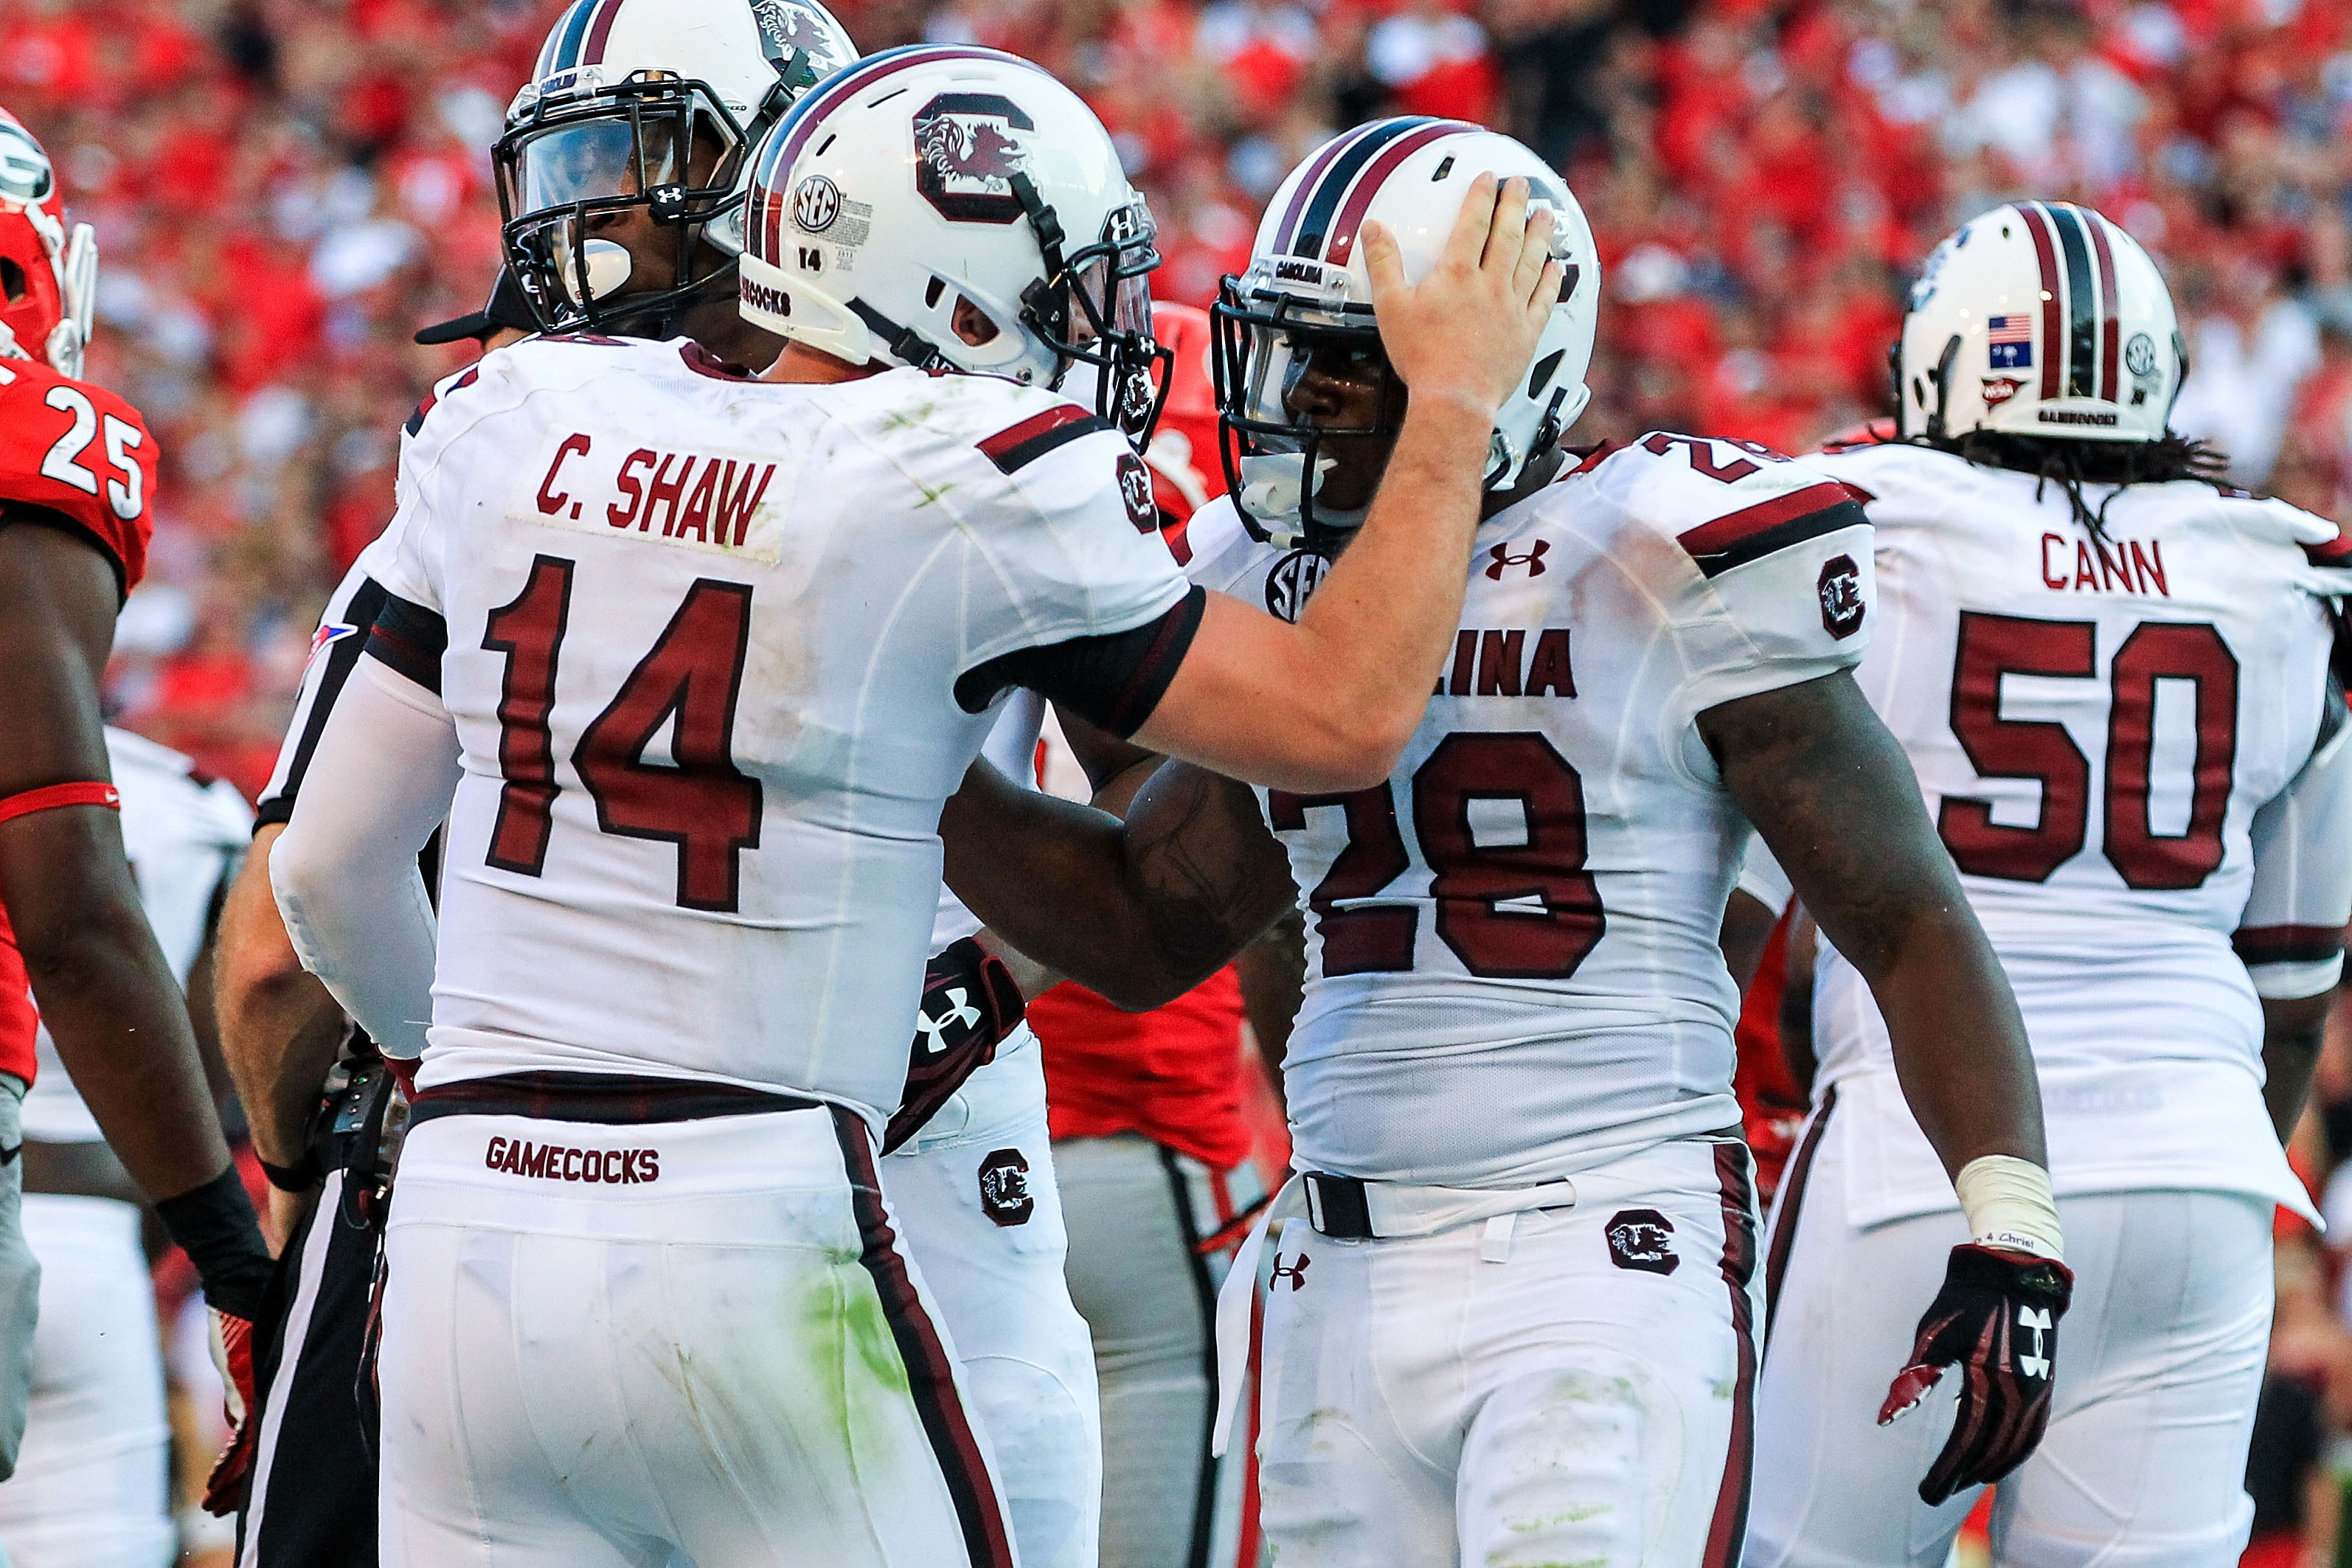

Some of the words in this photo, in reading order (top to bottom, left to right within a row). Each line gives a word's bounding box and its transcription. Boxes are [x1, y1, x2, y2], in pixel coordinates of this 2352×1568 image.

[796, 177, 837, 229] SEC
[799, 246, 822, 271] 14
[41, 386, 143, 521] 25
[536, 432, 591, 520] C.
[606, 448, 777, 547] SHAW
[2041, 533, 2170, 597] CANN
[480, 553, 763, 913] 14
[1937, 610, 2239, 890] 50
[1269, 731, 1606, 979] 28
[485, 1136, 659, 1184] GAMECOCKS
[1999, 1232, 2035, 1249] Christ
